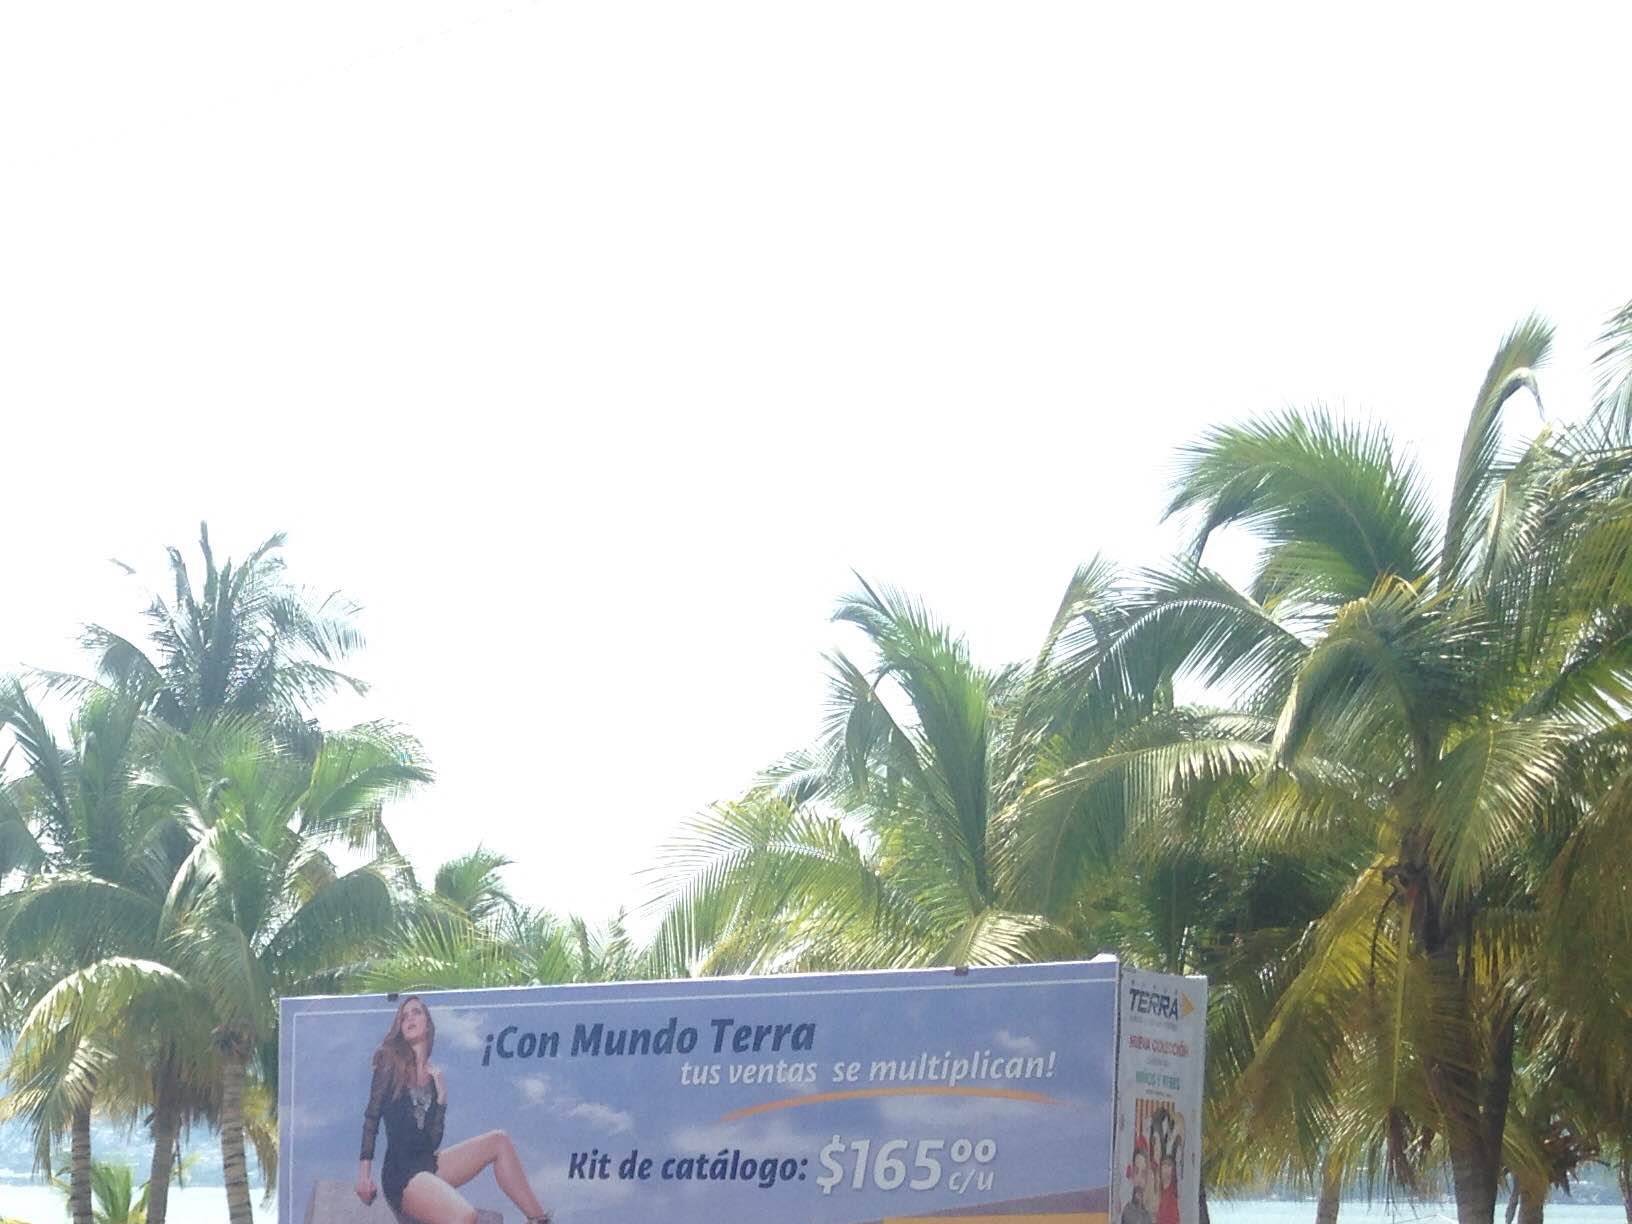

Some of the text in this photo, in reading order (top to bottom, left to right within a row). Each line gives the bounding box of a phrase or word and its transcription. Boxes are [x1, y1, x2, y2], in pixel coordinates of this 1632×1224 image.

[1129, 988, 1178, 1020] TERRA
[481, 1017, 816, 1066] ¡Con Mundo Terra
[680, 1050, 1057, 1087] tus ventas se multiplican!
[568, 1149, 611, 1181] Kit
[618, 1149, 651, 1180] de
[661, 1149, 808, 1188] catálogo:
[948, 1168, 995, 1194] c/u
